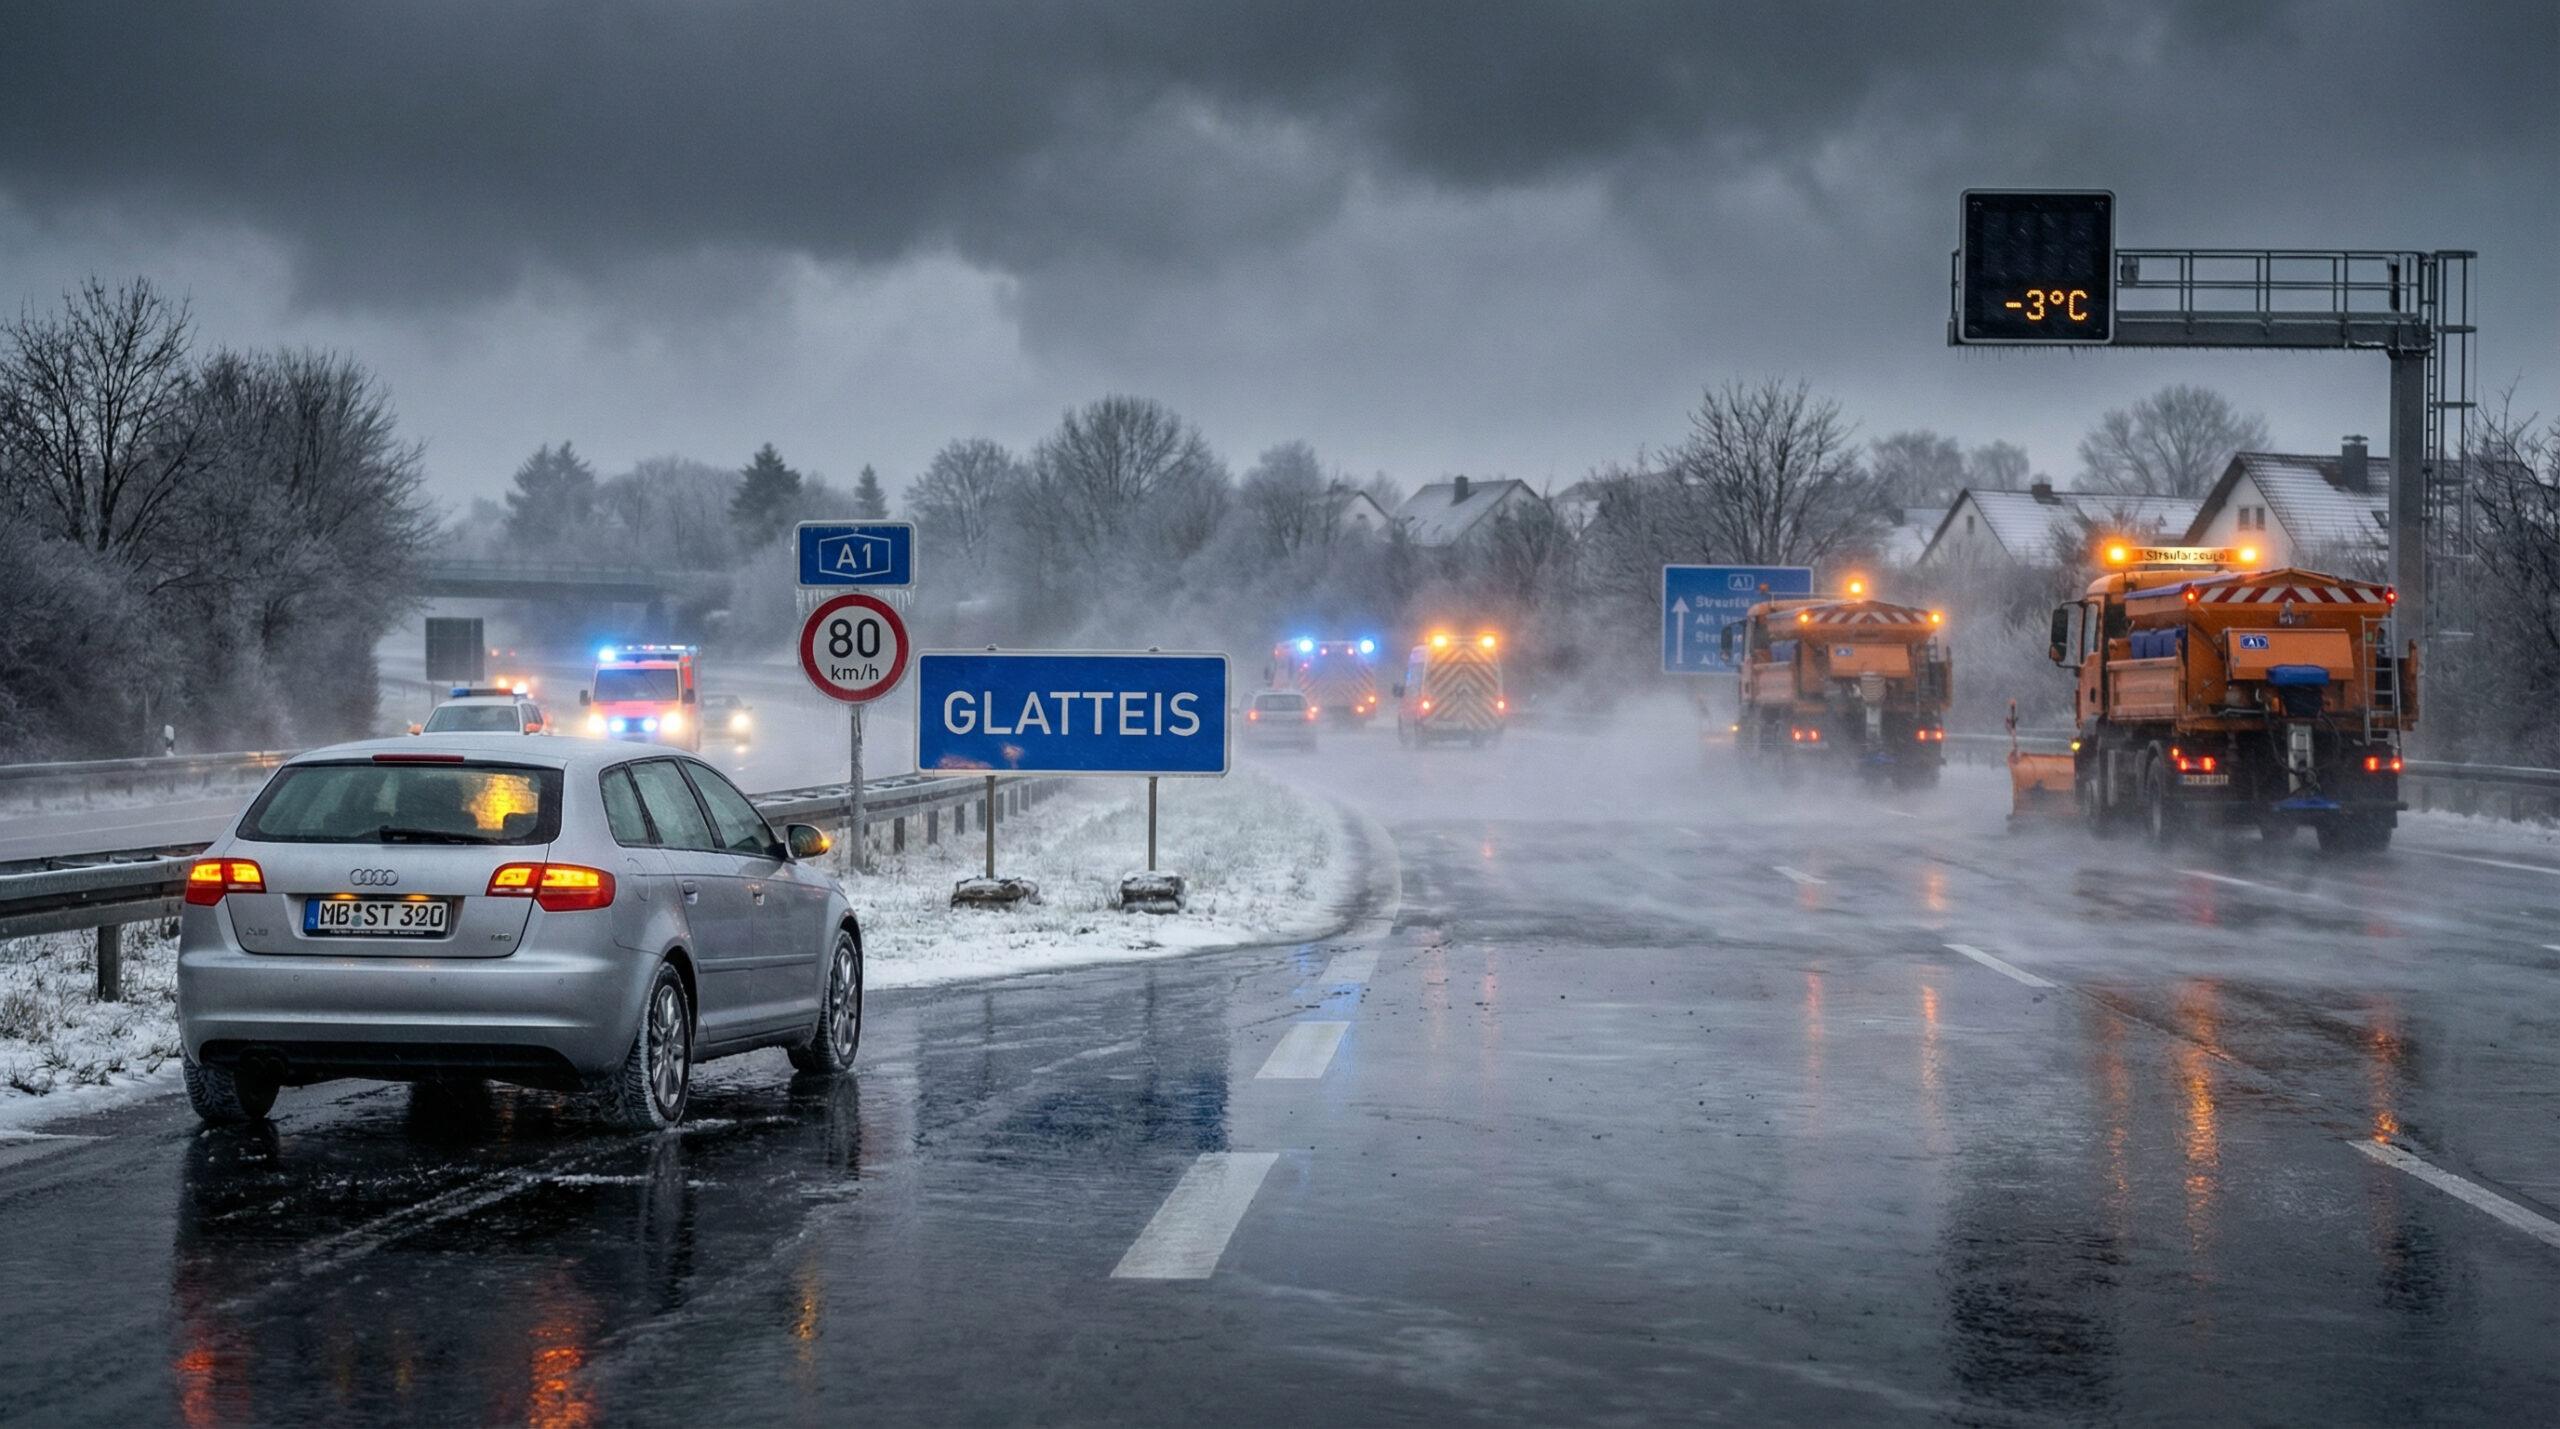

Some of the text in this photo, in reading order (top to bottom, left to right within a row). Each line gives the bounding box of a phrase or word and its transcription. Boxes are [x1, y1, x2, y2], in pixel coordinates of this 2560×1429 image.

[2005, 289, 2088, 320] -3°C
[836, 543, 871, 569] A1
[828, 618, 881, 658] 80
[831, 664, 879, 680] km/h
[943, 690, 1201, 736] GLATTEIS
[319, 902, 350, 926] MB
[363, 903, 395, 927] ST
